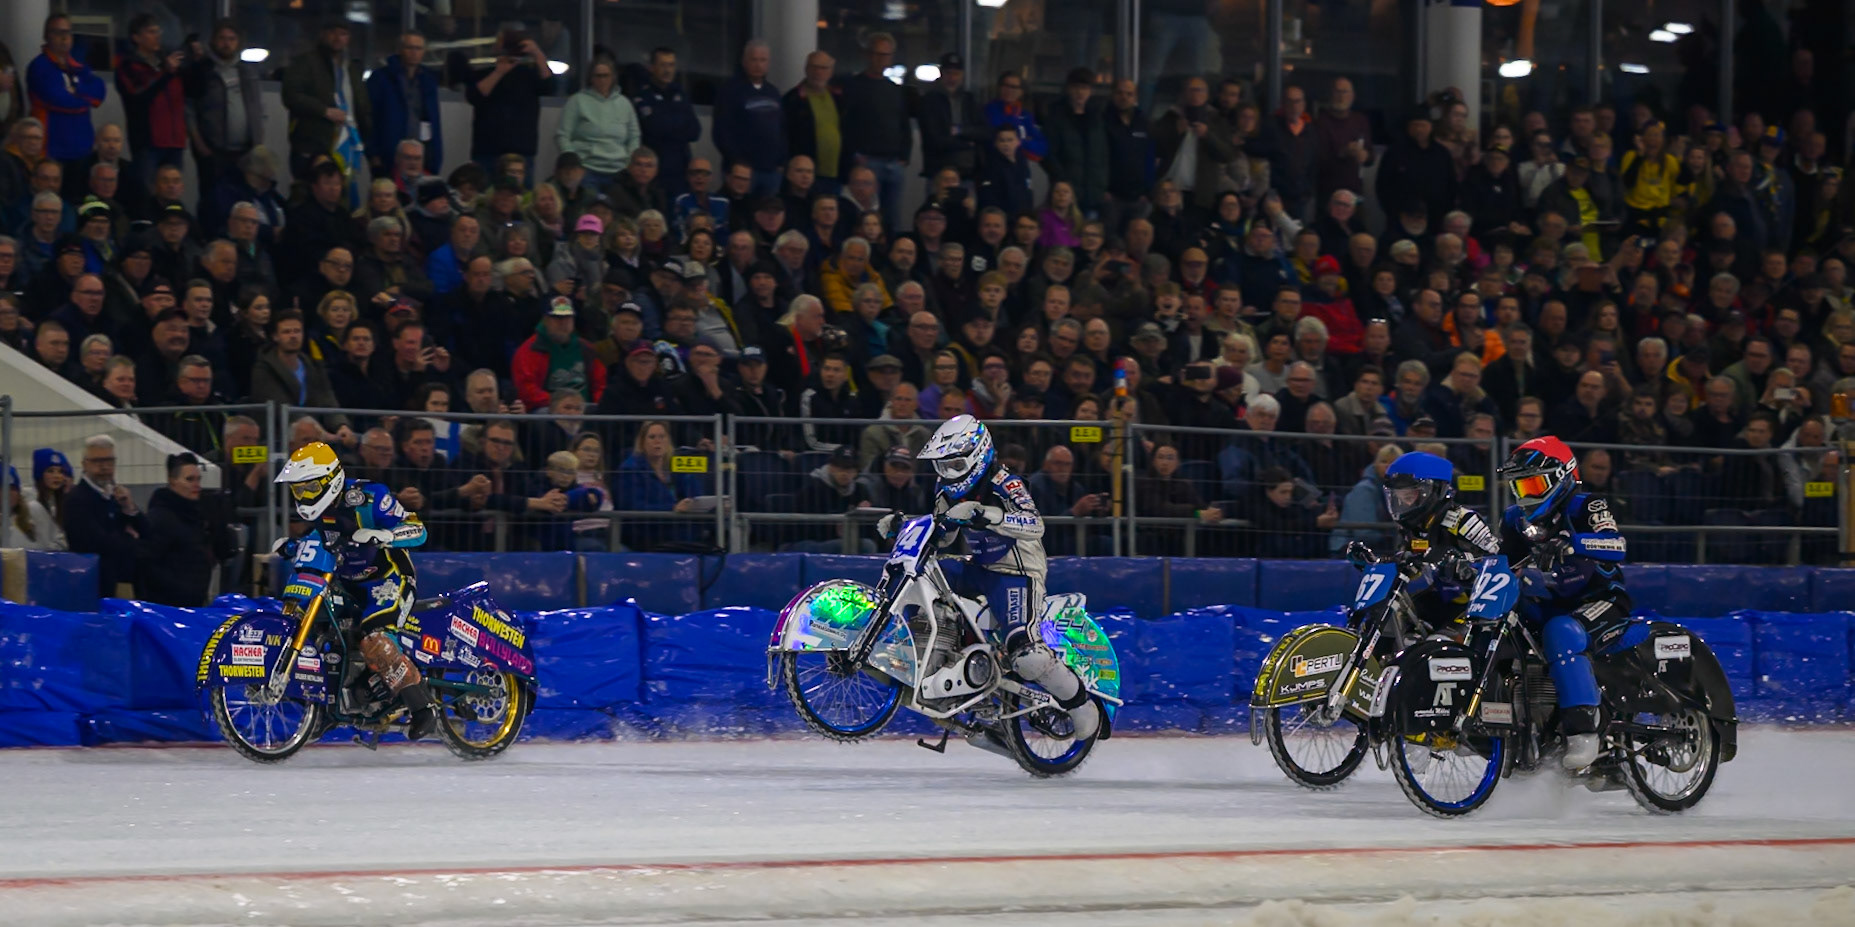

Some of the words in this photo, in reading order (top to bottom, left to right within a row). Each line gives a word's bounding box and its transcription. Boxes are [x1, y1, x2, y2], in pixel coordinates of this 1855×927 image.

[453, 617, 478, 640] HACHER
[473, 605, 526, 649] THORWESTEN
[233, 647, 263, 657] HACHER
[219, 665, 265, 678] THORWESTEN
